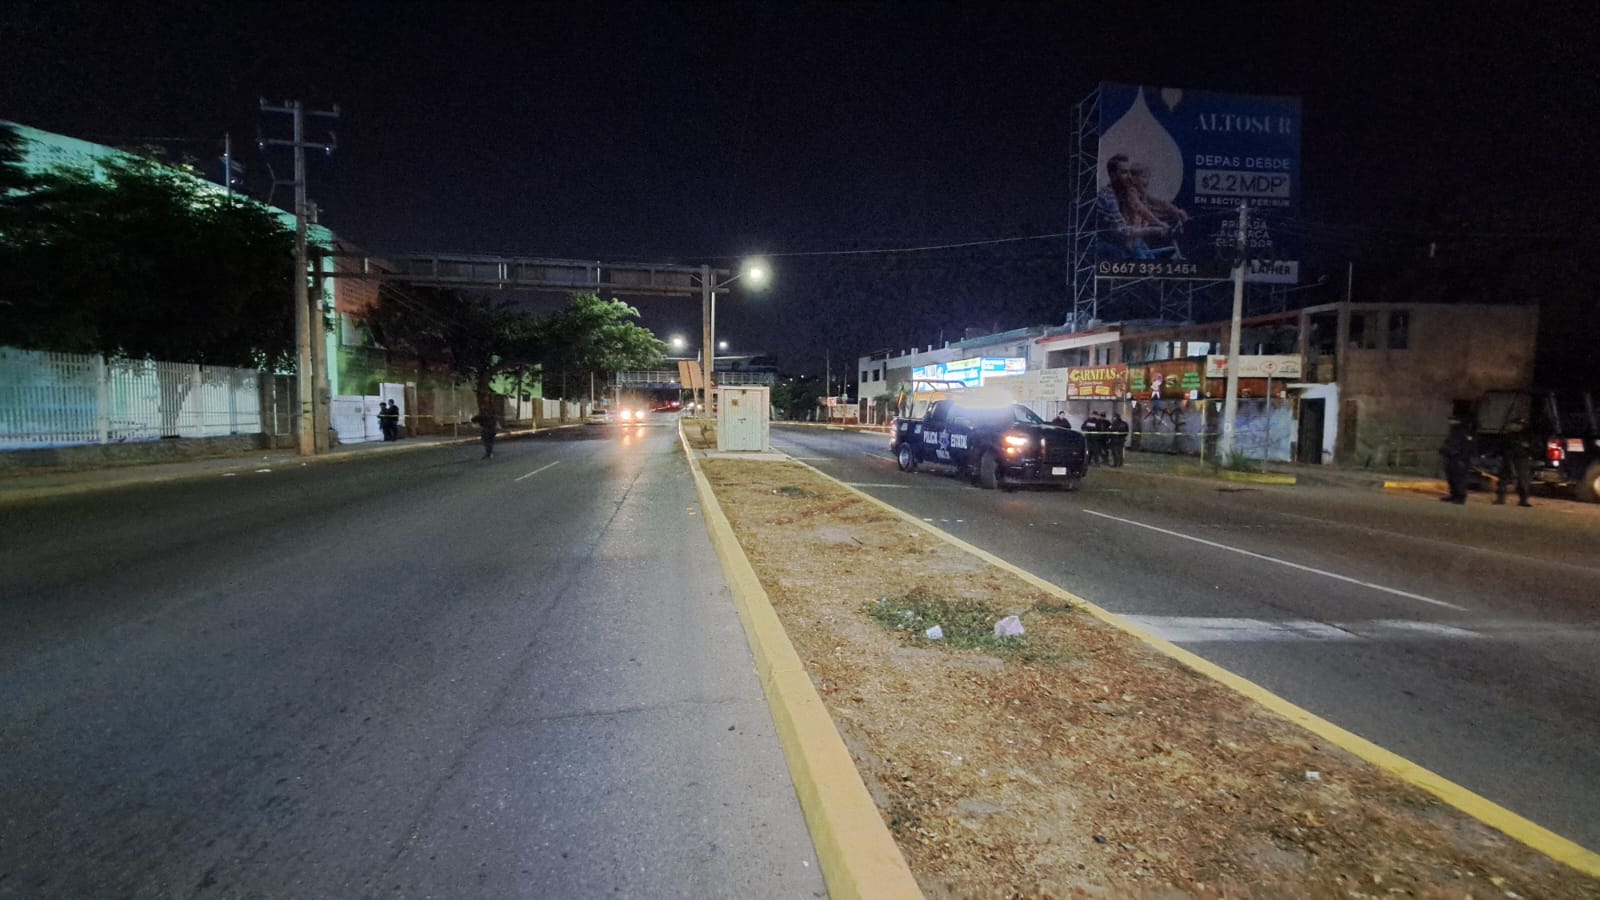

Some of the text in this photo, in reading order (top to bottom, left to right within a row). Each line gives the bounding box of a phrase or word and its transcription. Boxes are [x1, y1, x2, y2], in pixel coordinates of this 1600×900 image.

[1195, 154, 1290, 169] DEPAS DESDE
[1202, 174, 1238, 192] $2.2
[1194, 196, 1208, 204] EN
[1210, 197, 1242, 206] SECTO
[1112, 263, 1135, 274] 667
